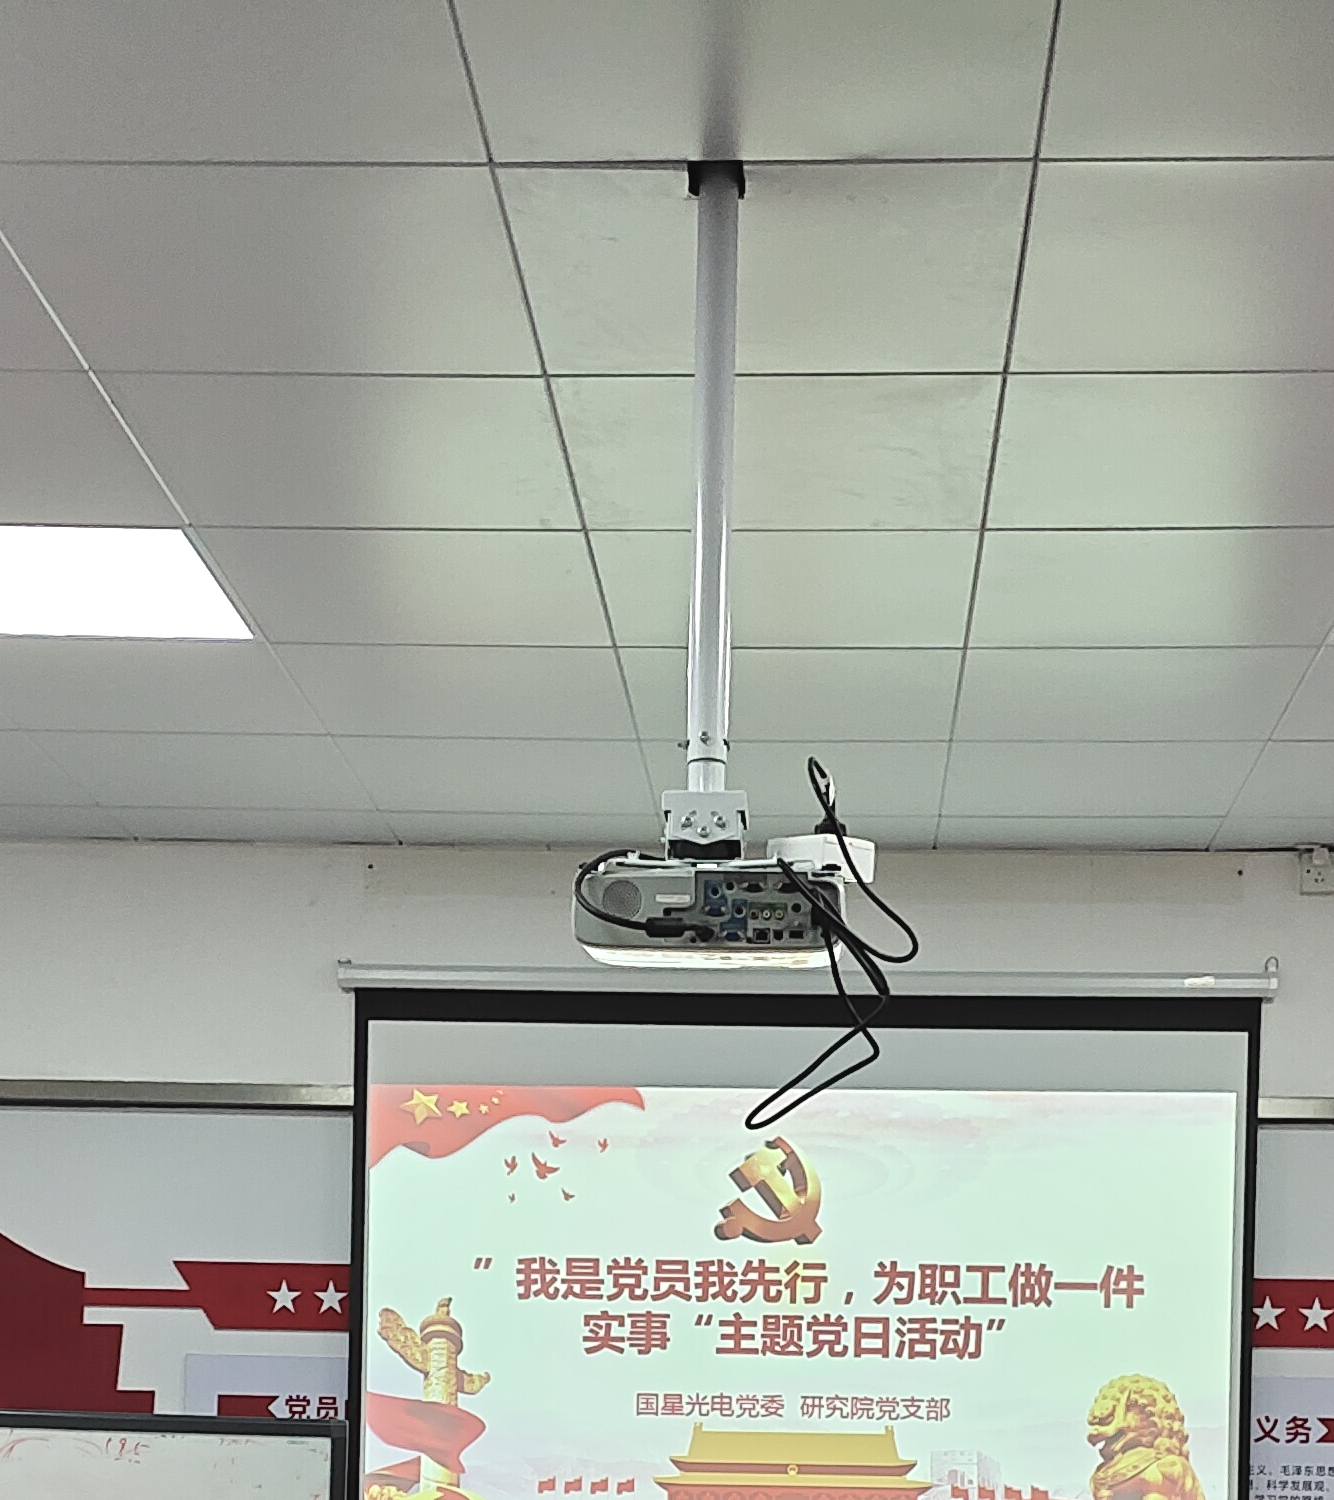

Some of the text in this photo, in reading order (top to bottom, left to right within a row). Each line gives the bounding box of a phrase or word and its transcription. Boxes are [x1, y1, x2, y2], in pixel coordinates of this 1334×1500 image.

[285, 1395, 340, 1420] 党员
[636, 1393, 951, 1422] 国星光电党委 研究院党支部
[1253, 1416, 1312, 1444] 义务
